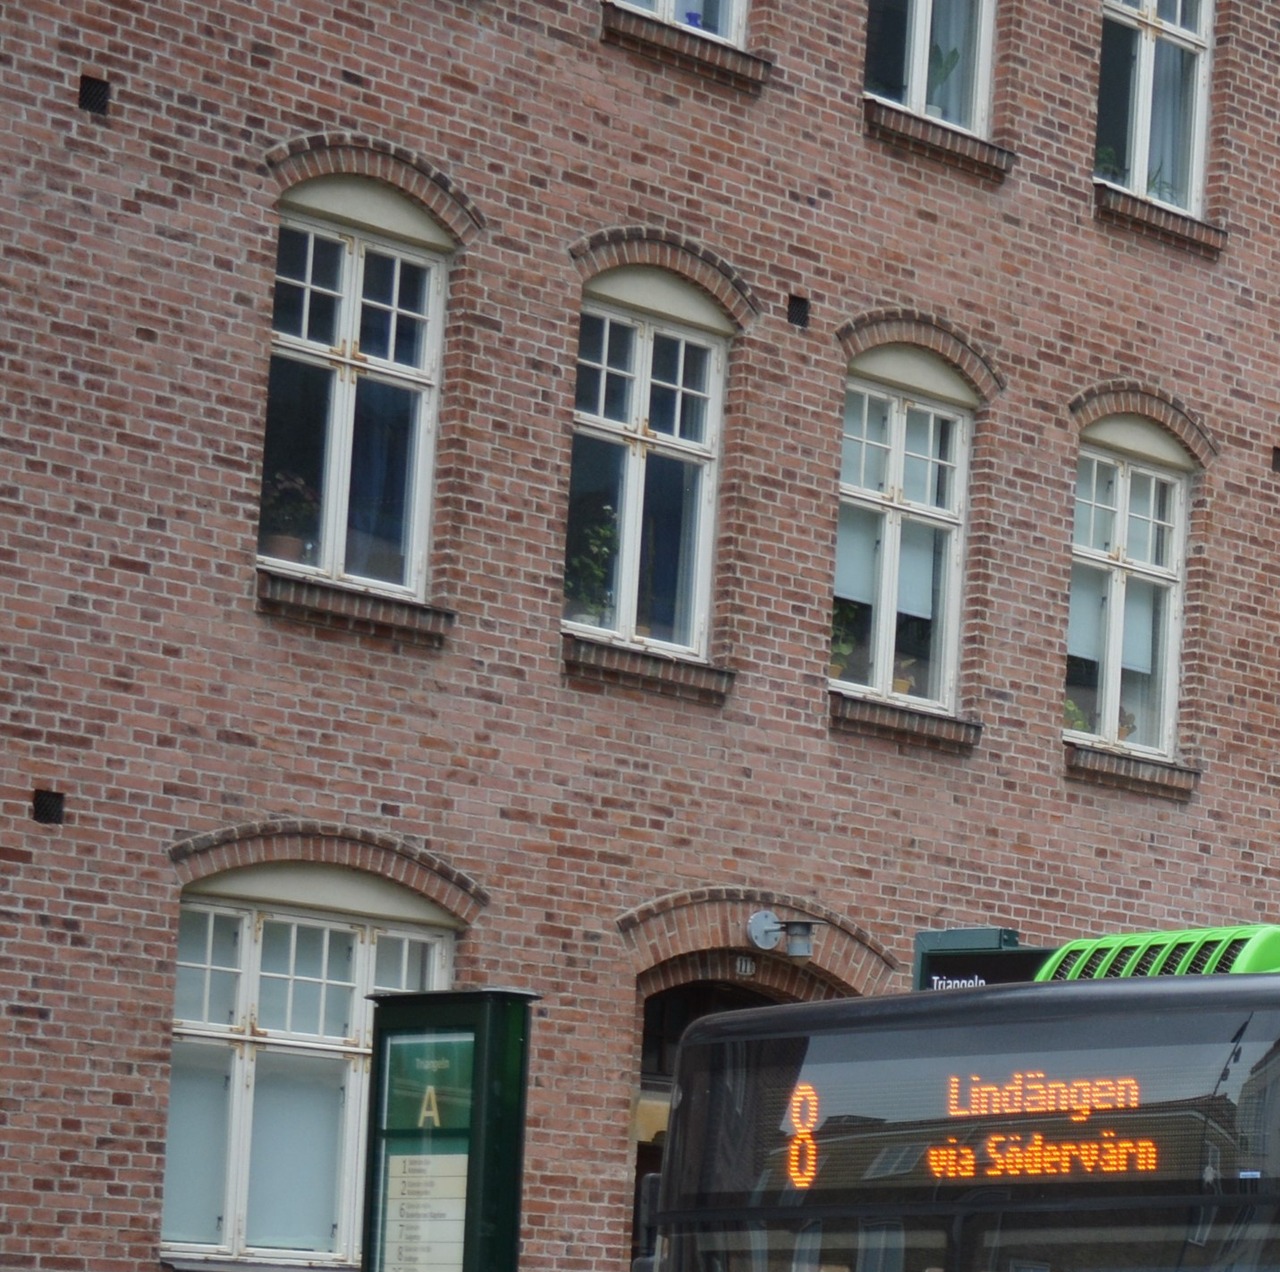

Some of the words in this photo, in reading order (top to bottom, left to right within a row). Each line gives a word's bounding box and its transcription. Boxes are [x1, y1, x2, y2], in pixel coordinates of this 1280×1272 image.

[417, 1085, 441, 1128] A
[948, 1071, 1141, 1123] Lindängen
[786, 1083, 819, 1189] 8
[928, 1138, 976, 1178] via
[986, 1131, 1158, 1178] Södervärn
